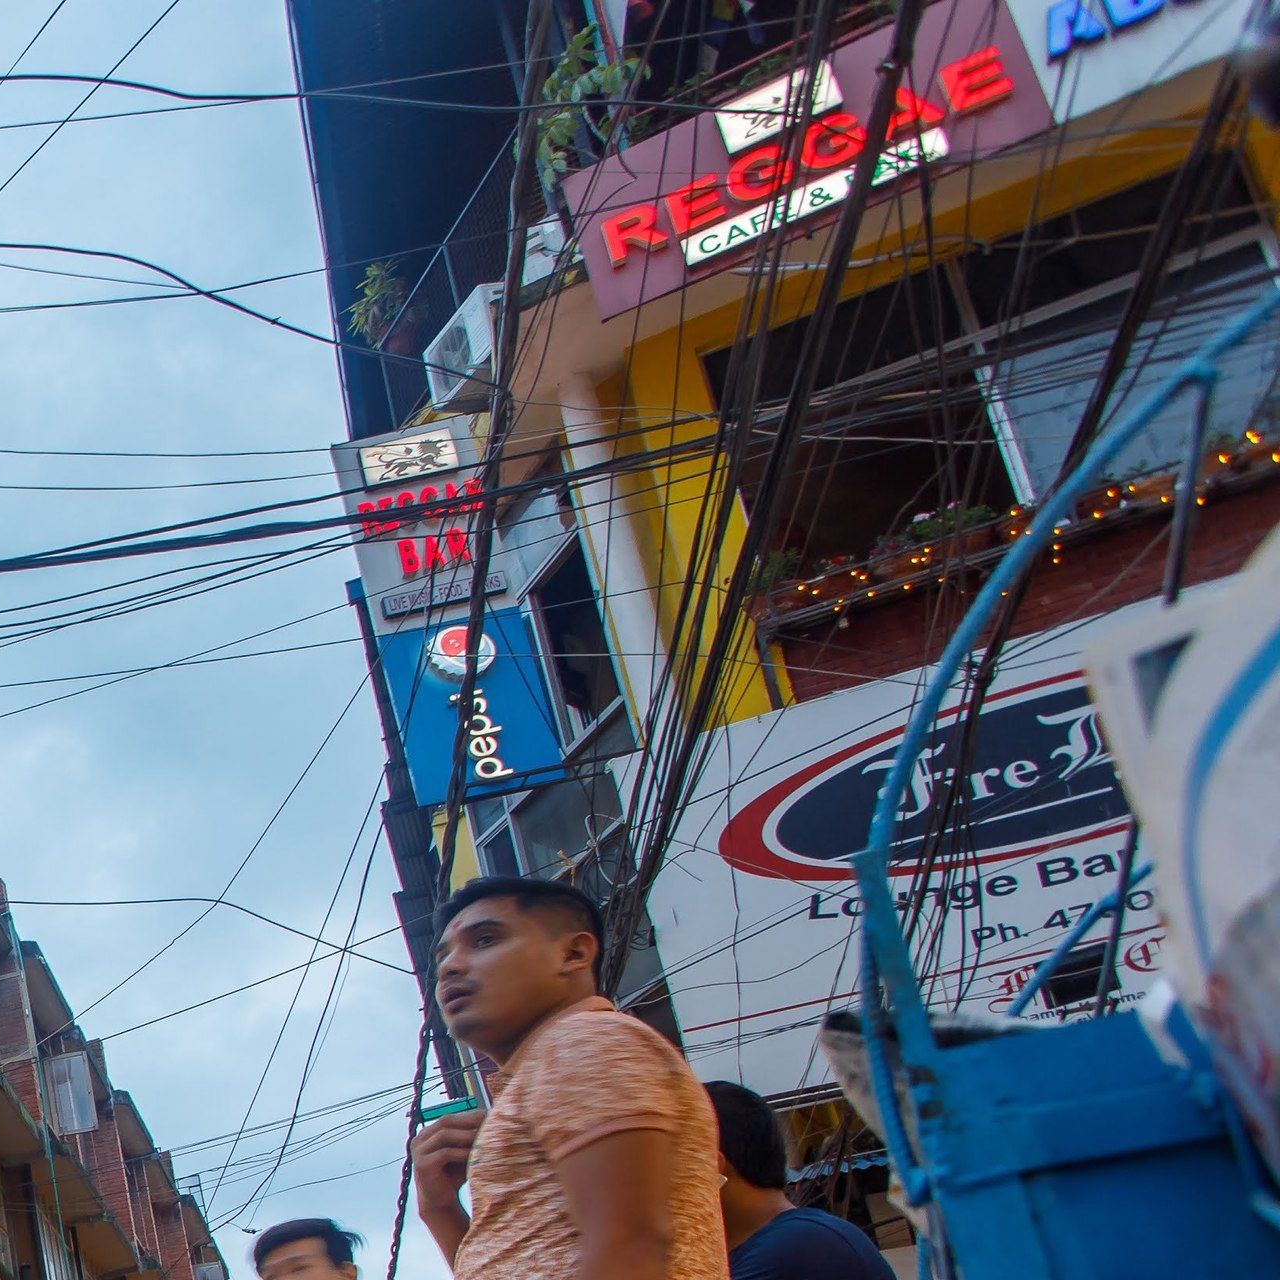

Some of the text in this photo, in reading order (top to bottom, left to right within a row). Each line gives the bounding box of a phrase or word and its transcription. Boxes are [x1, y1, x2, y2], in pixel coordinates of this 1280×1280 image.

[601, 45, 1015, 269] REGGAE
[397, 528, 471, 575] BAR
[808, 852, 1130, 920] Longe Ba
[970, 922, 1029, 949] Ph.
